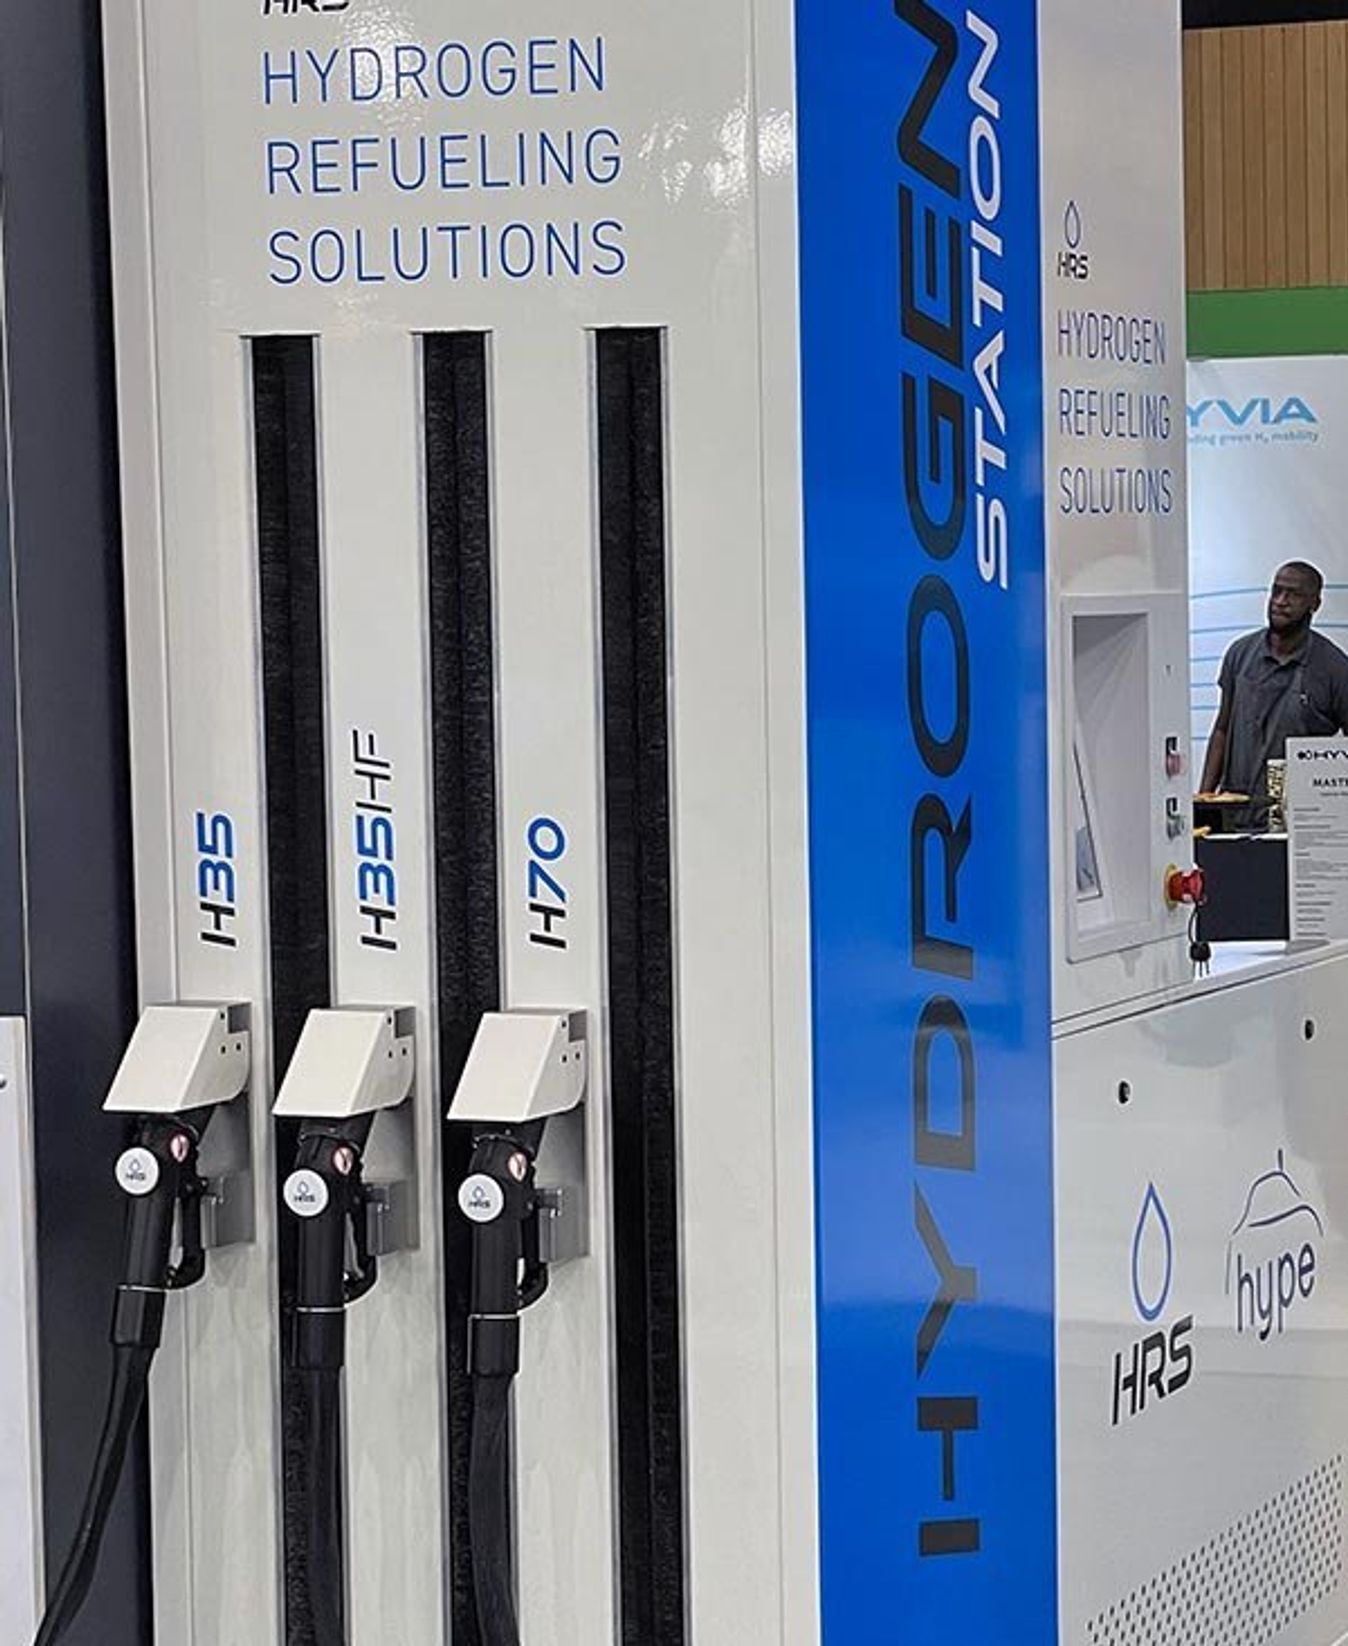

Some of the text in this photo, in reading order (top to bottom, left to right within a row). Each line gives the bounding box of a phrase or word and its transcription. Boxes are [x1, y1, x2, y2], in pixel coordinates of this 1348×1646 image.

[263, 36, 604, 105] HYDROGEN
[266, 128, 622, 195] REFUELING
[268, 220, 626, 285] SOLUTIONS
[1057, 252, 1089, 279] HRS
[965, 9, 1008, 590] STATION
[1057, 310, 1166, 365] HYDROGEN
[1059, 388, 1171, 440] REFUELING
[1060, 466, 1172, 514] SOLUTIONS
[893, 0, 979, 1557] HYDROGEN
[196, 811, 238, 948] H35
[526, 816, 568, 949] H70
[1236, 1242, 1316, 1341] hype
[1111, 1314, 1195, 1426] HRS
